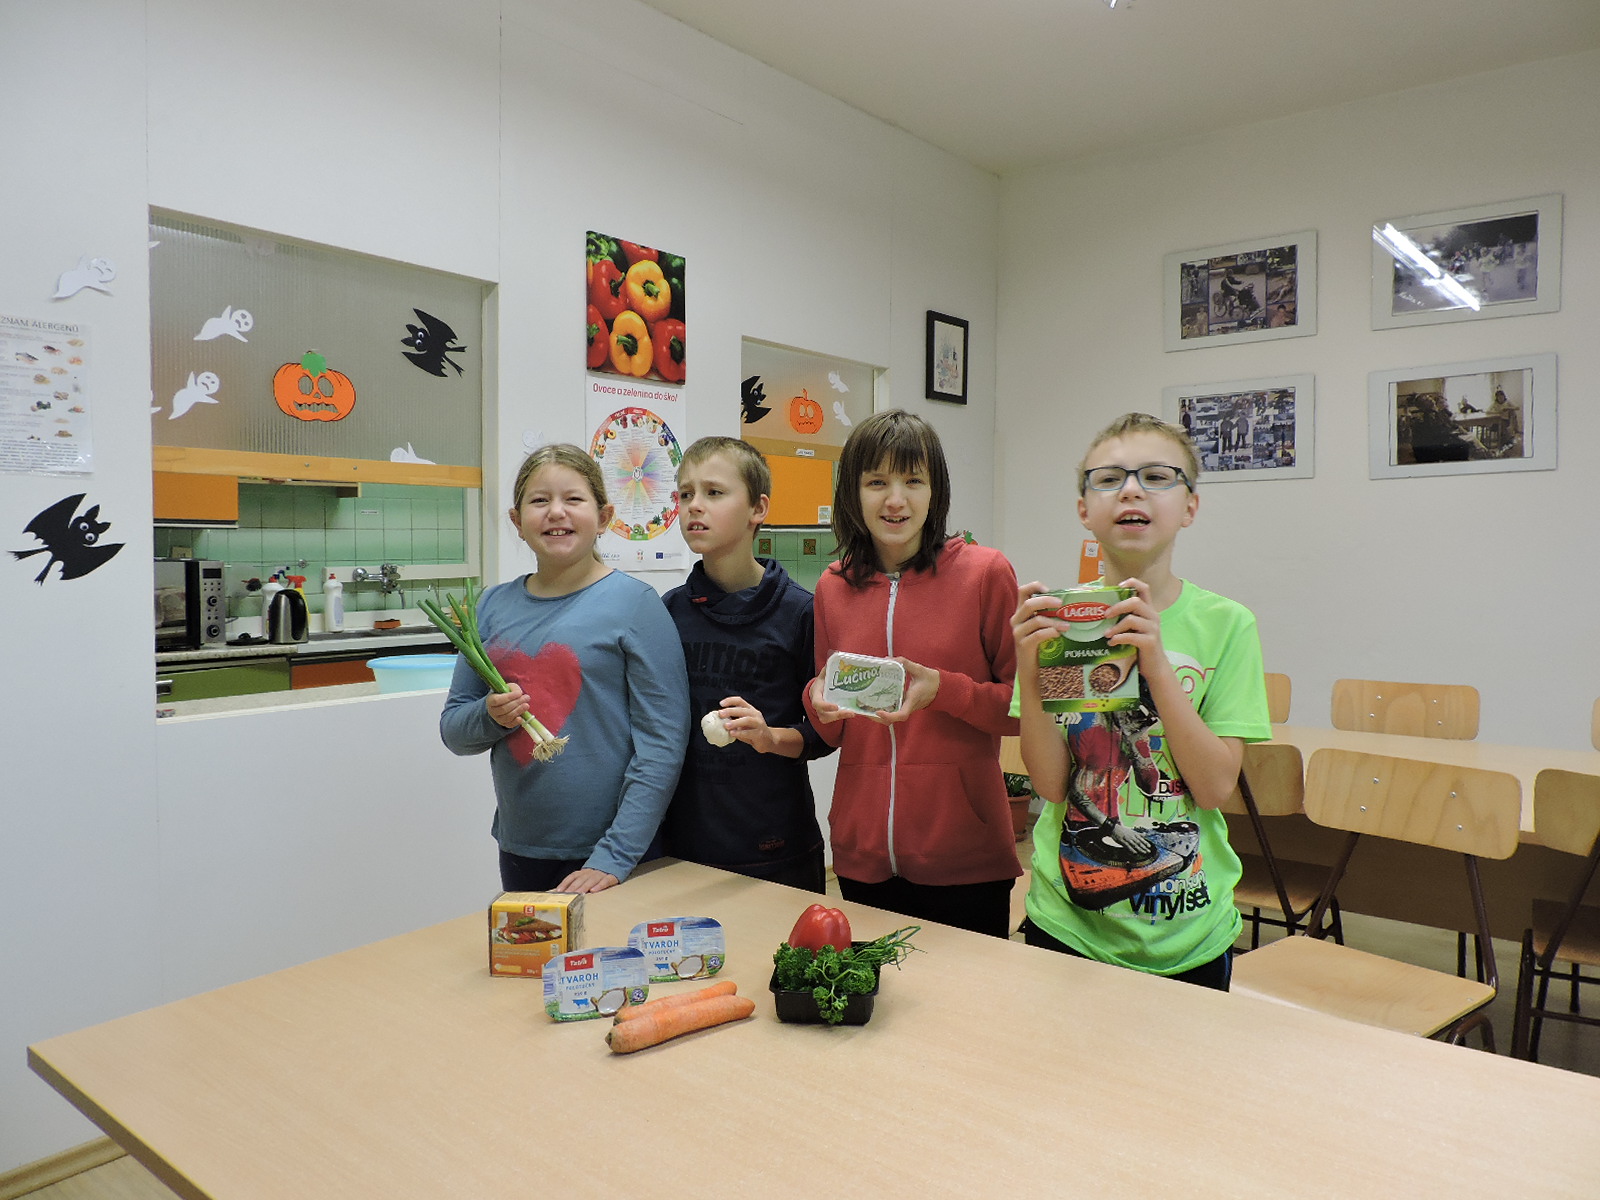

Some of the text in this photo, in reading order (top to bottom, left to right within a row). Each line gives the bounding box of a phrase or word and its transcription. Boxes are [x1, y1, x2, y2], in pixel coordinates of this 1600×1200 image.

[593, 383, 616, 394] Ovoce
[623, 388, 653, 399] zelenina
[654, 392, 663, 401] do
[1063, 605, 1105, 618] LAGRIS
[643, 940, 679, 949] TVAROH
[560, 972, 599, 985] TVAROH
